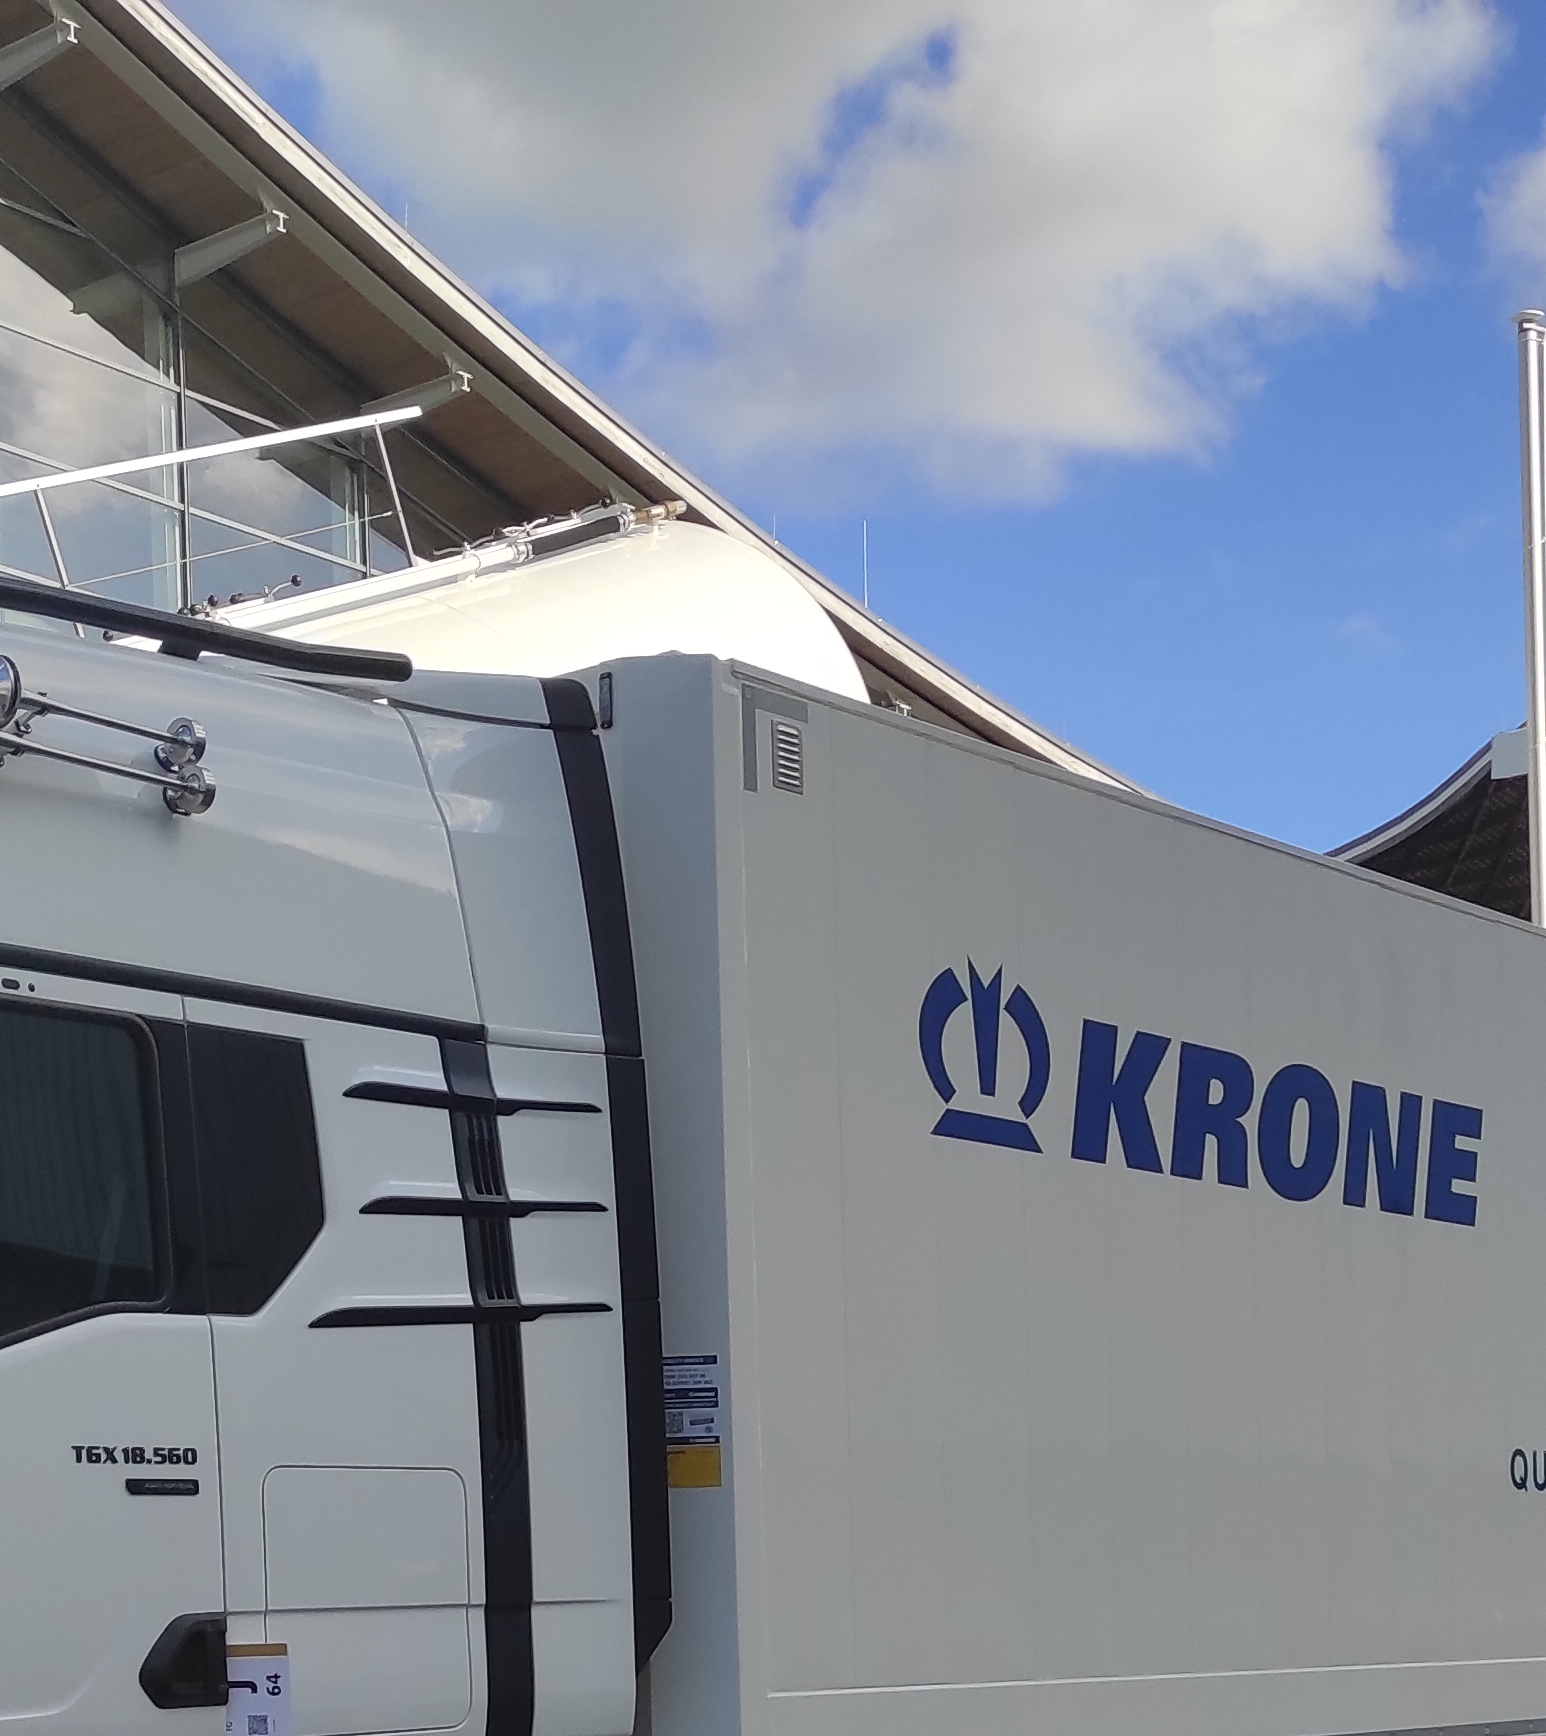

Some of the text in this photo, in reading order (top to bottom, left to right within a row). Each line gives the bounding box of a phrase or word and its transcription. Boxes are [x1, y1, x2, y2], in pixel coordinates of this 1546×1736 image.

[1071, 1017, 1484, 1227] KRONE
[71, 1445, 198, 1466] TGX 18.560
[265, 1673, 282, 1697] 64
